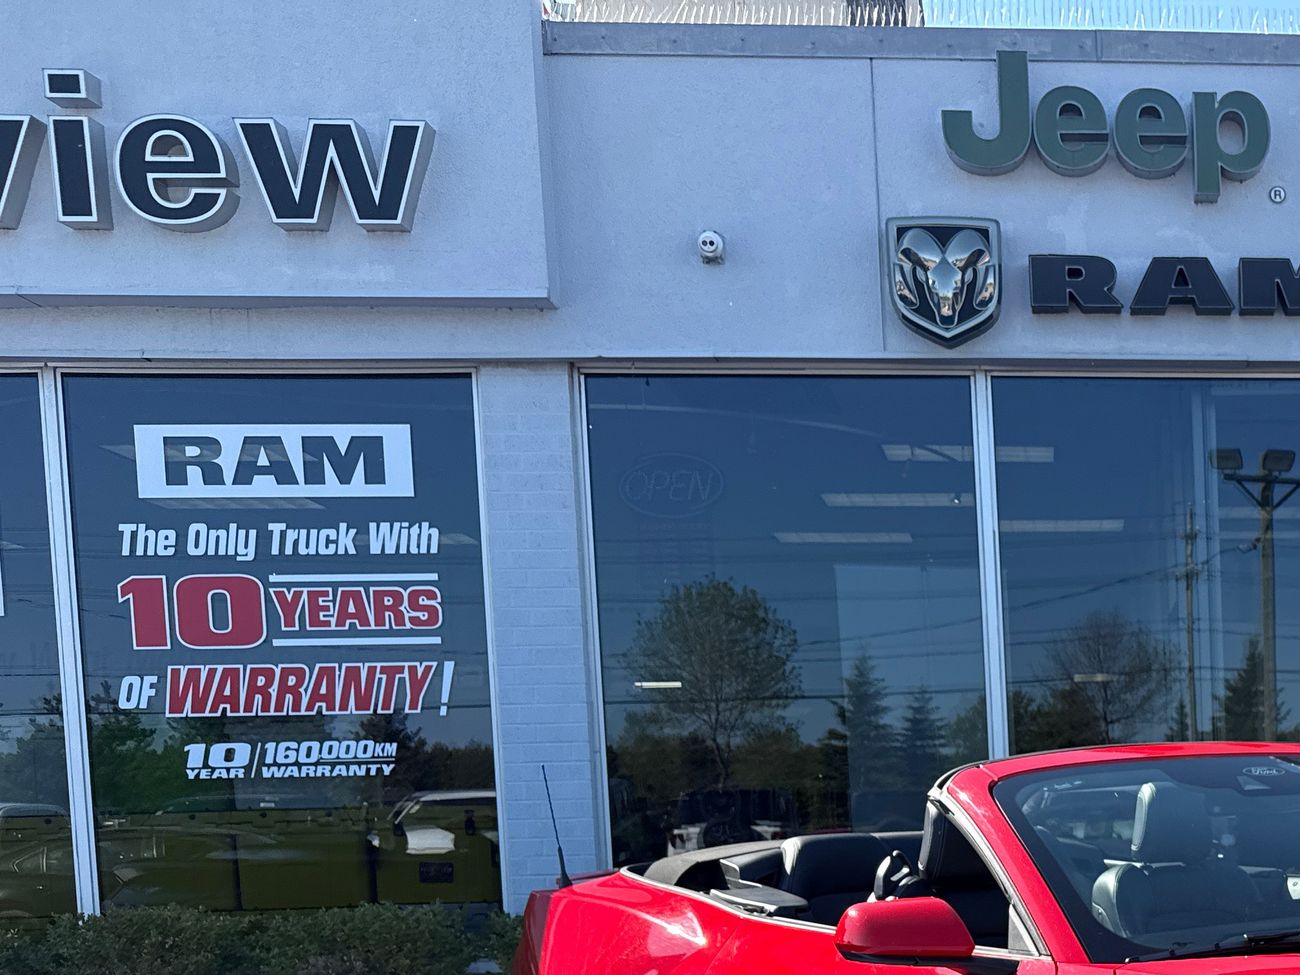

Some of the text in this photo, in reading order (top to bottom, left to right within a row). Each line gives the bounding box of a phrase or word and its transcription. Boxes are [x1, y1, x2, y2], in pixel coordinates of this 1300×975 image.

[941, 50, 1271, 203] Jeep
[162, 435, 386, 487] RAM
[625, 469, 713, 502] OPEN
[118, 521, 439, 561] The Only Truck With
[117, 573, 443, 650] 10 YEARS
[117, 675, 158, 709] OF
[184, 742, 252, 768] 10
[185, 764, 395, 780] YEAR WARRANTY
